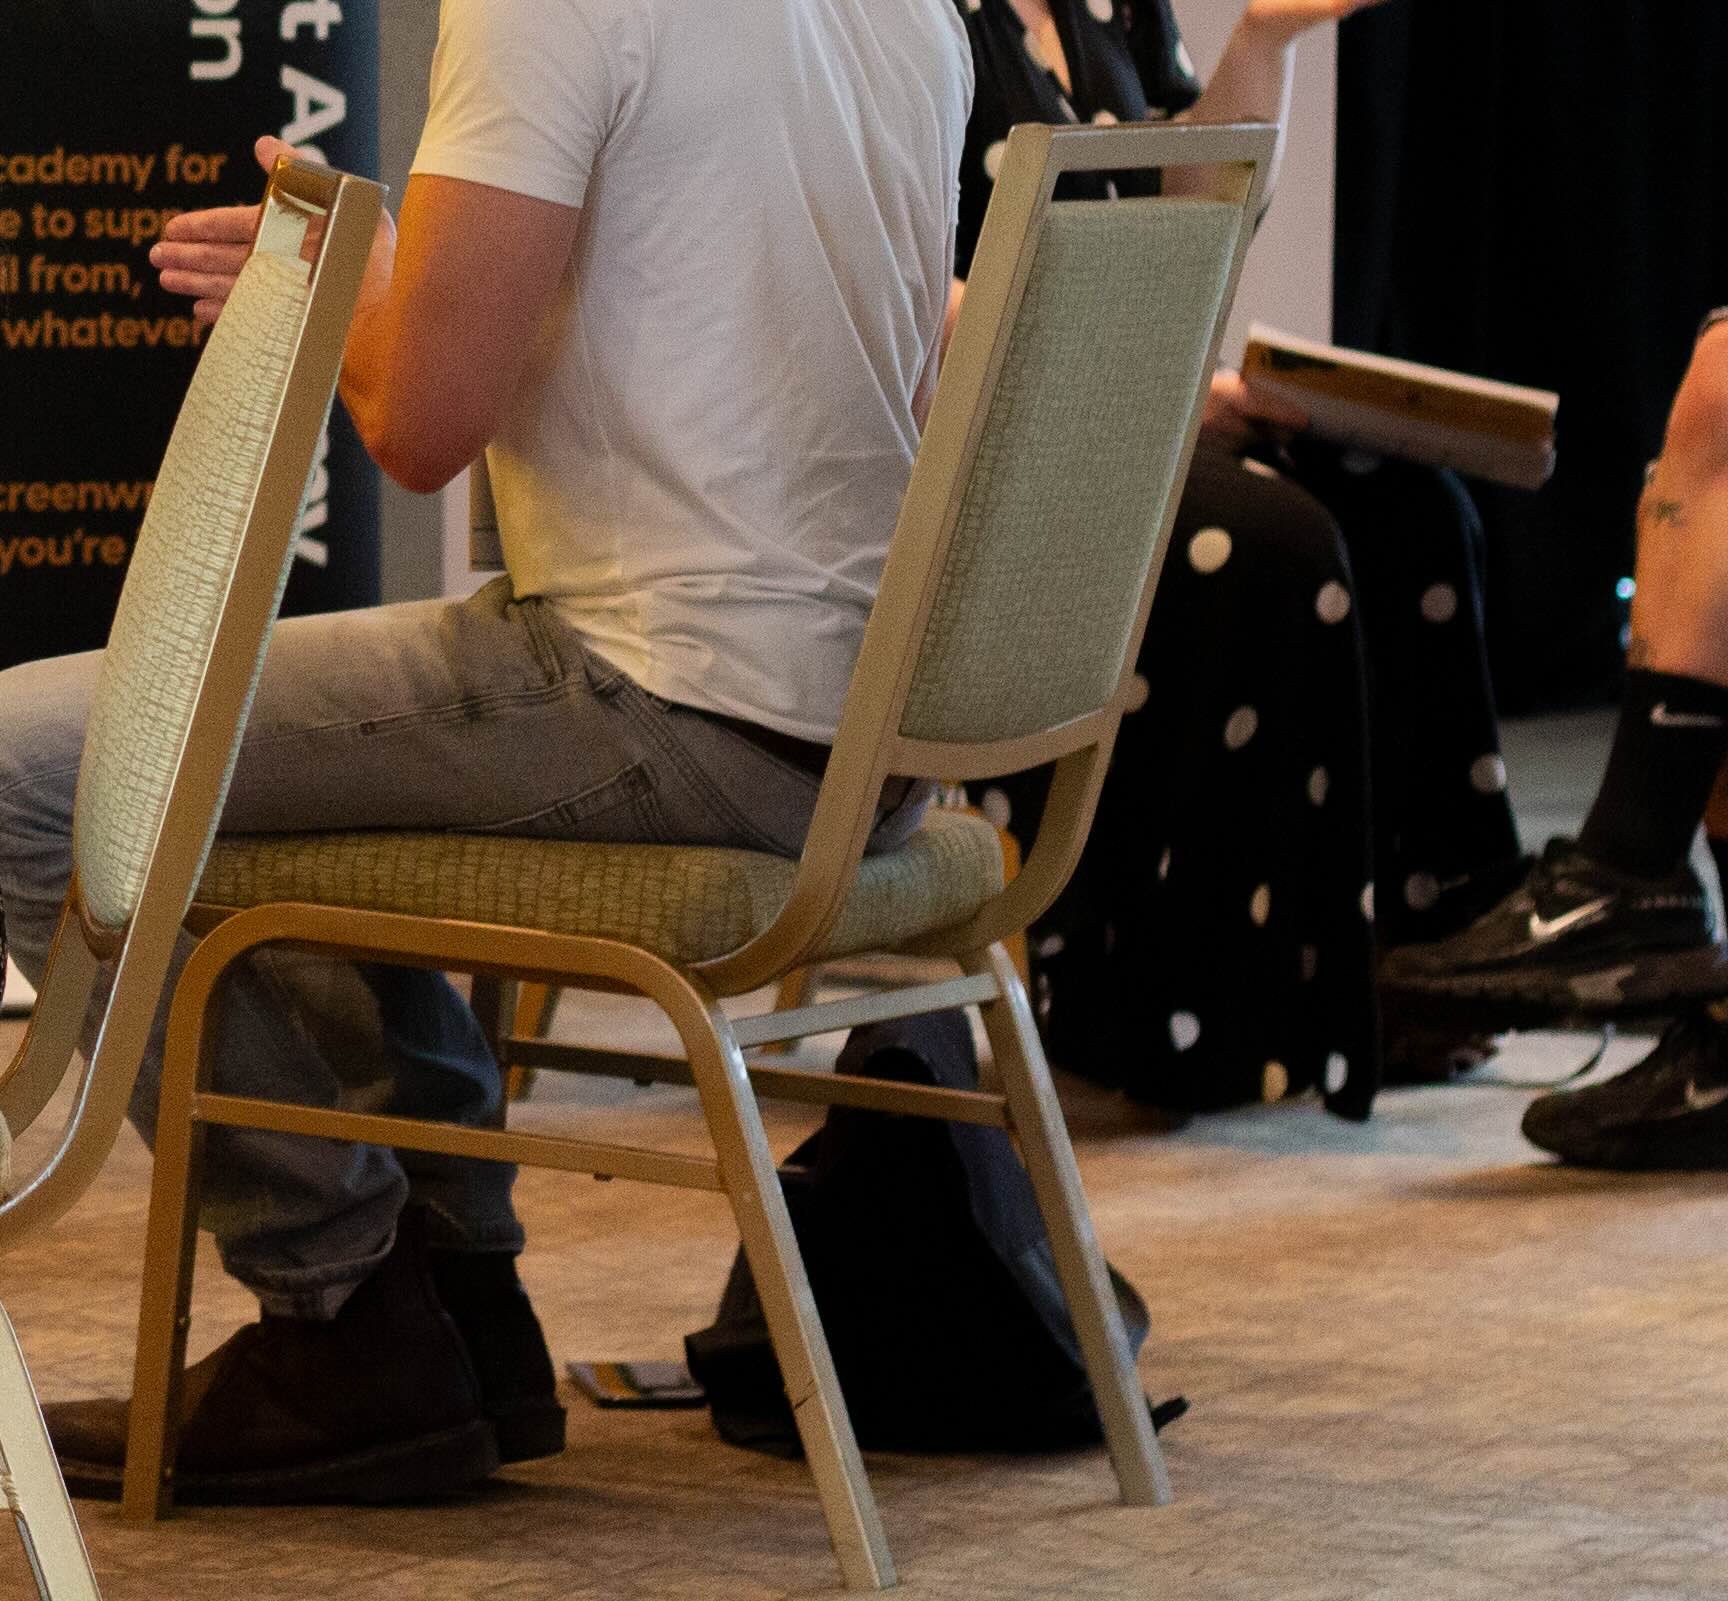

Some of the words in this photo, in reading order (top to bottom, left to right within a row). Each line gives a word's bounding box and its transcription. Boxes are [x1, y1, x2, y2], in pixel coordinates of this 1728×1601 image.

[166, 144, 227, 185] for
[32, 203, 76, 241] to
[30, 256, 142, 298] from,
[1, 311, 202, 349] whatever
